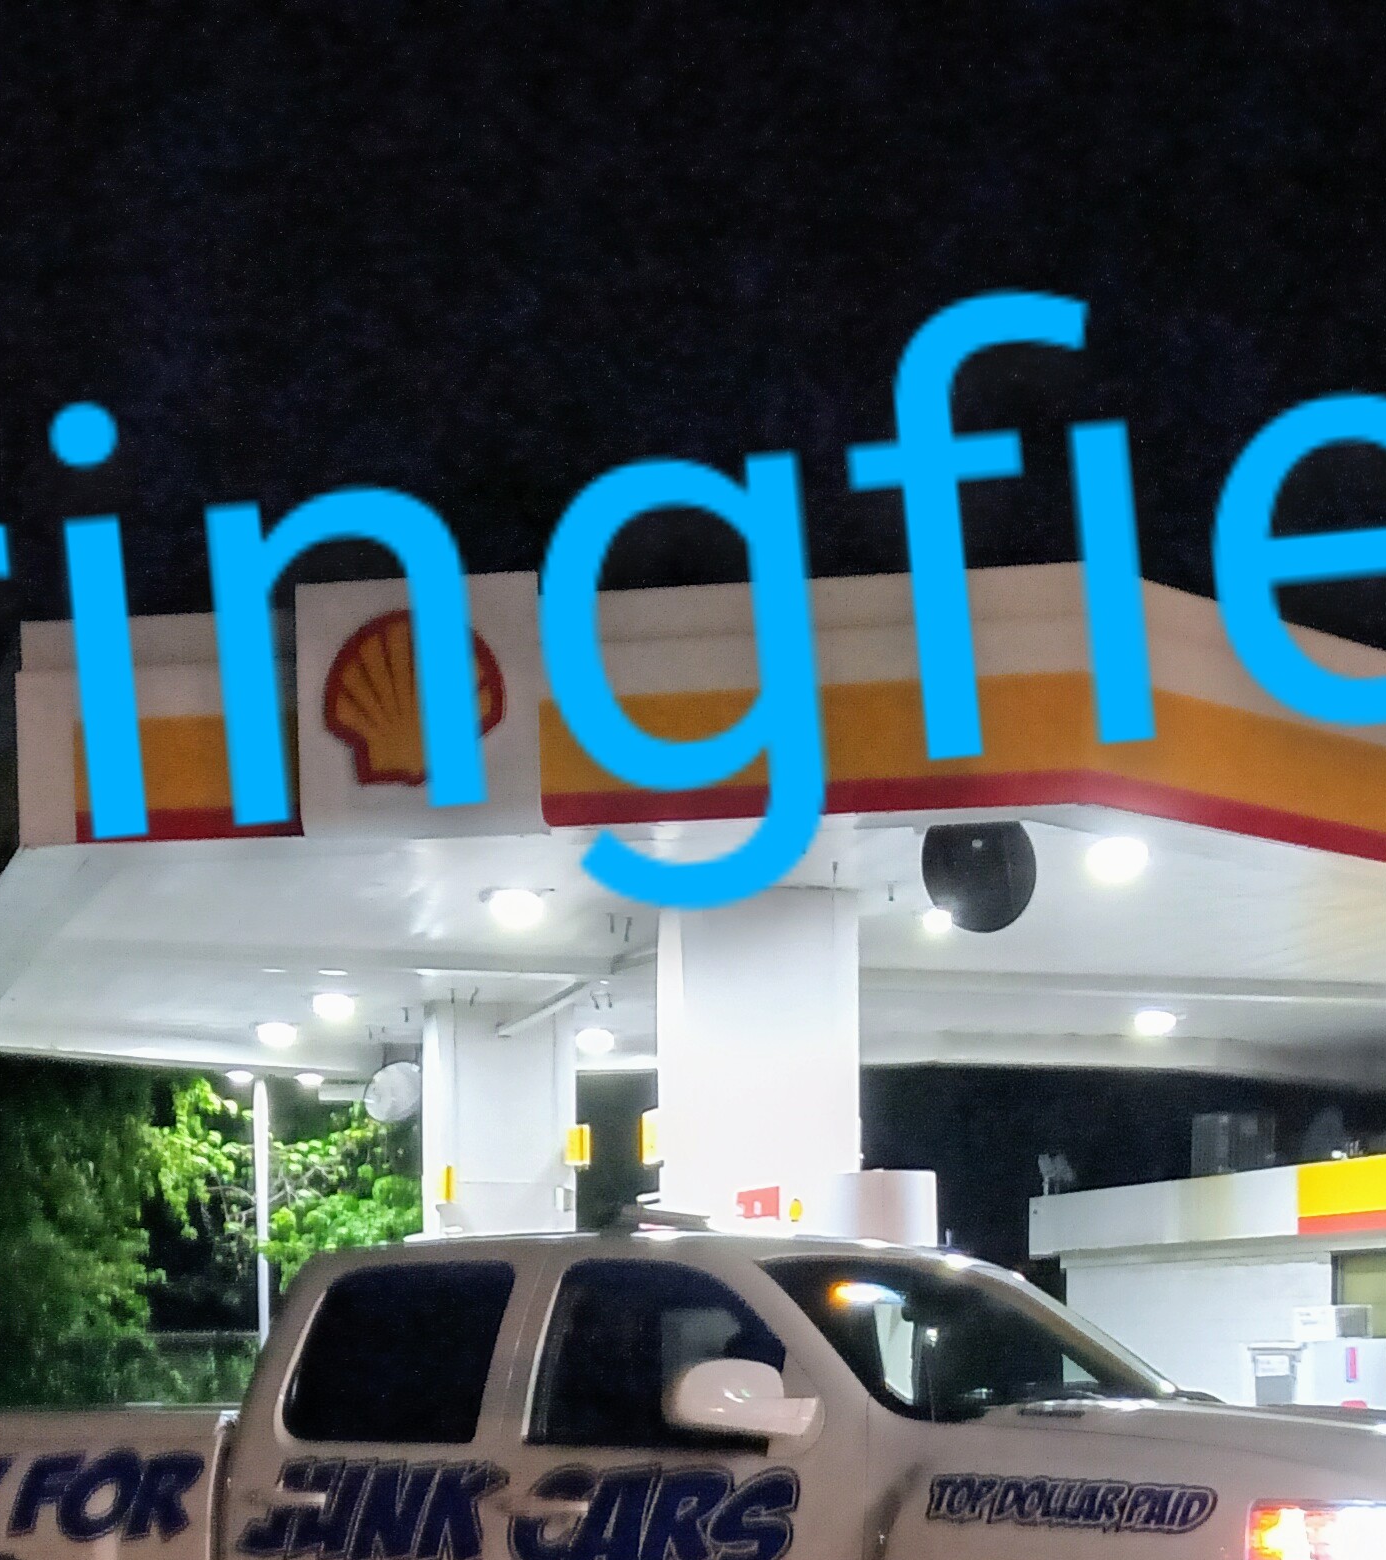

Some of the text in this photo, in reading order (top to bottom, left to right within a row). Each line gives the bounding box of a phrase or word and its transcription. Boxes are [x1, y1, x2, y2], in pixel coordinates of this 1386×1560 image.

[7, 1447, 205, 1543] FOR
[926, 1473, 1218, 1534] TOP DOLLAR PAID
